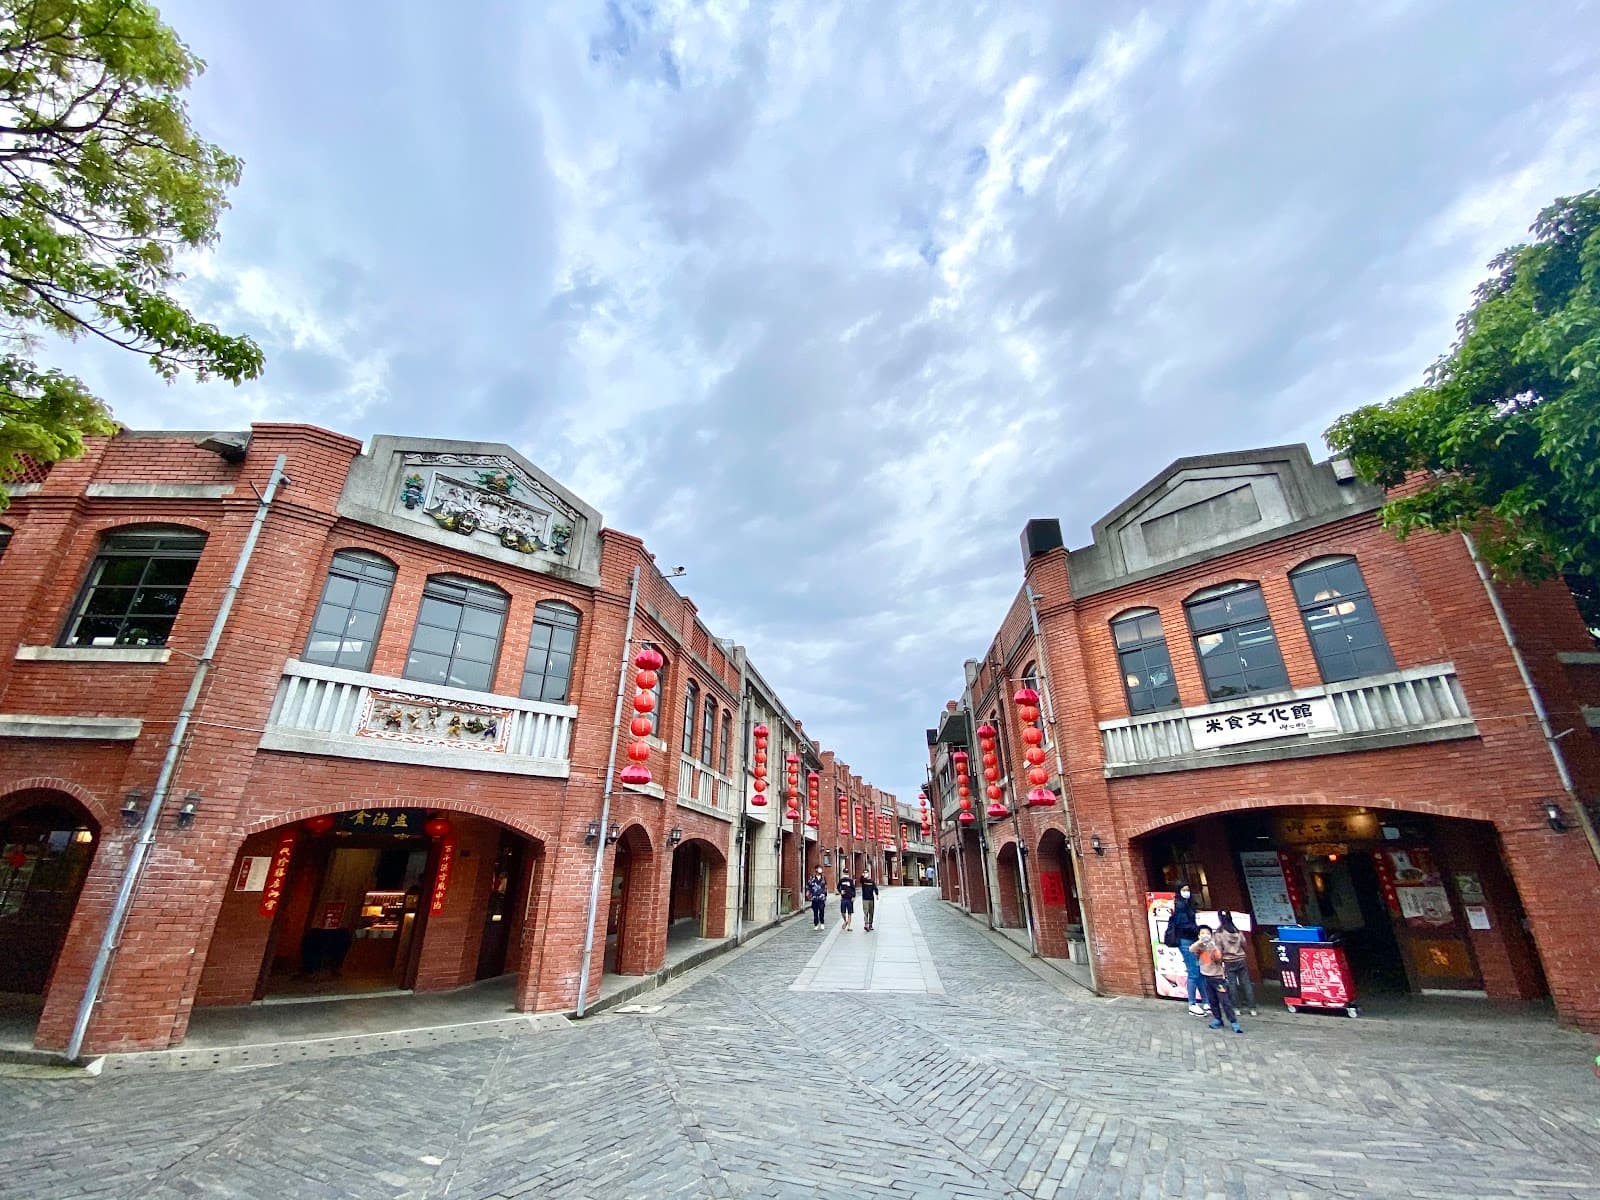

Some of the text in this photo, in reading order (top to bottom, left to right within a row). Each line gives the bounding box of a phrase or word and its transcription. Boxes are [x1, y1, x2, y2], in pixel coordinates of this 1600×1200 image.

[1206, 703, 1312, 733] 米食文化館
